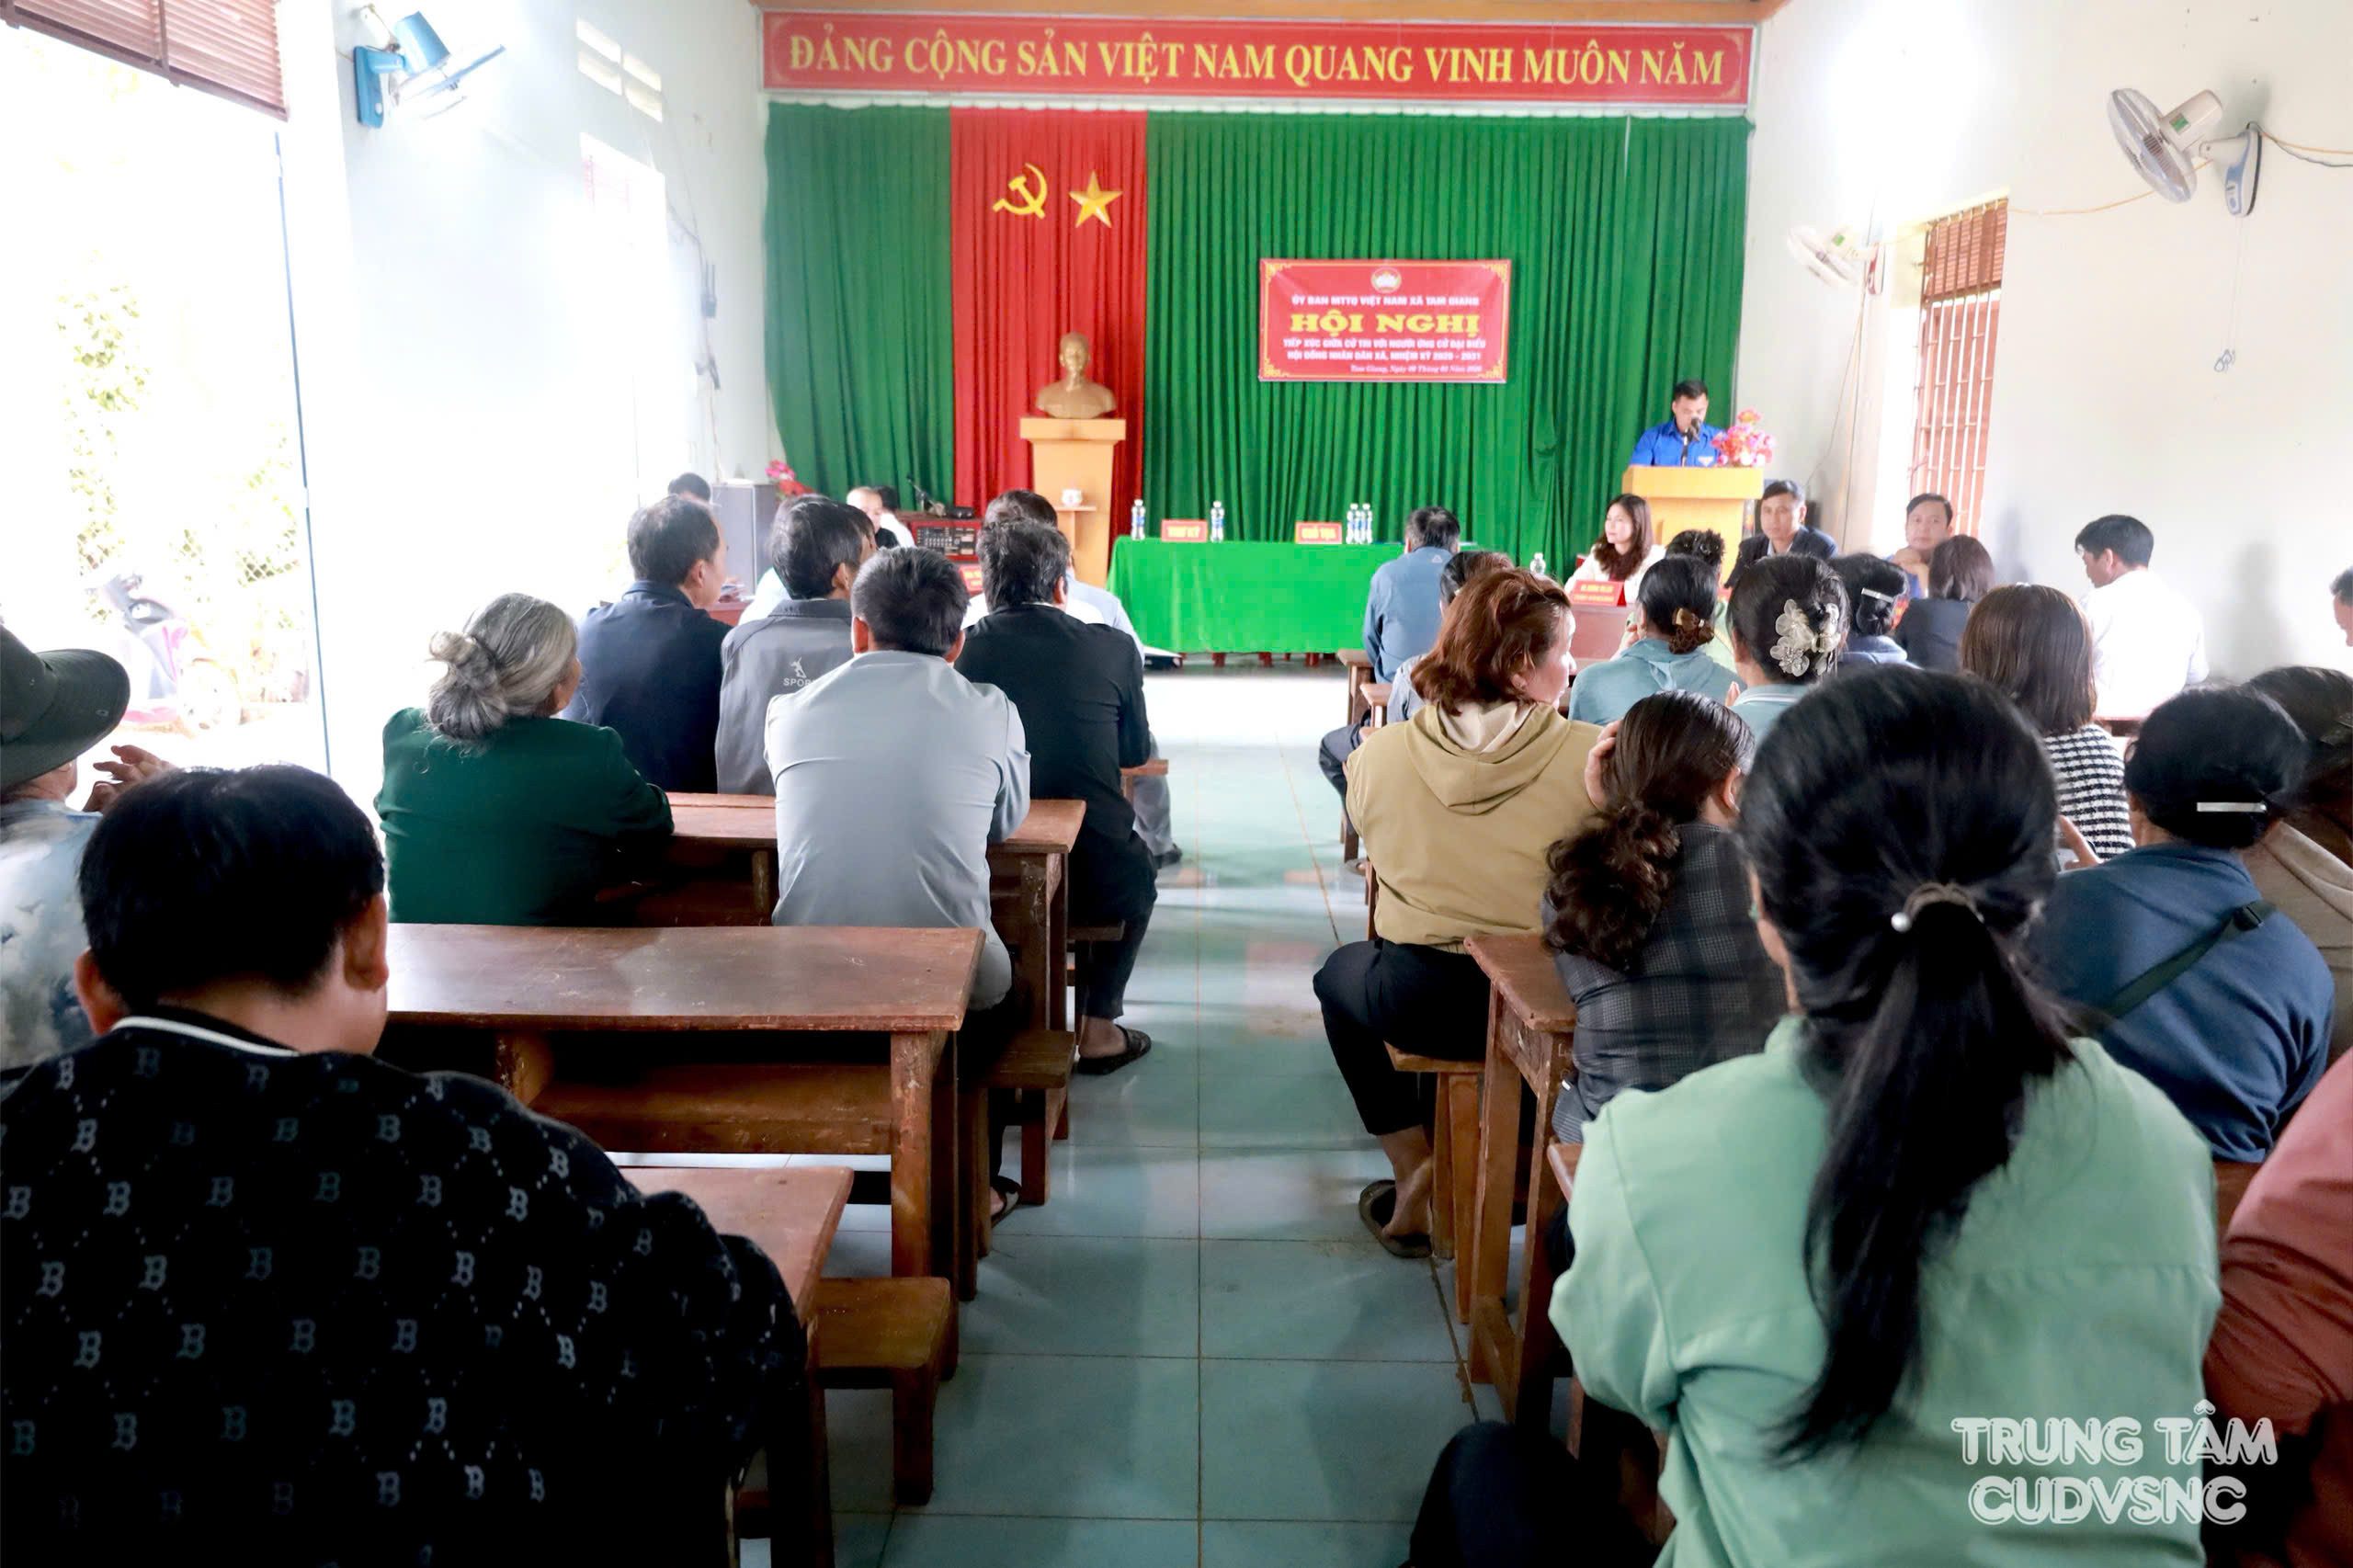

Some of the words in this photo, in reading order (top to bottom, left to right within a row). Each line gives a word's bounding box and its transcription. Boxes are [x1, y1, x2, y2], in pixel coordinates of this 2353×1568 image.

[789, 29, 893, 72] ĐẢNG
[904, 29, 1007, 80] CỘNG
[1017, 29, 1088, 77] SẢN
[1097, 32, 1186, 85] VIỆT
[1193, 43, 1277, 80] NAM
[1284, 44, 1414, 87] QUANG
[1425, 47, 1513, 83] VINH
[1522, 40, 1632, 85] MUÔN
[1639, 41, 1724, 85] NĂM
[1307, 296, 1328, 306] BAN
[1360, 295, 1381, 308] VIỆT
[1383, 296, 1406, 306] NAM
[1426, 296, 1447, 306] TAM
[1449, 296, 1480, 306] GIANG
[1290, 308, 1364, 338] HỘI
[1375, 313, 1480, 338] NGHỊ
[782, 677, 815, 687] SPOR
[68, 1119, 98, 1153] B
[377, 1112, 403, 1143] B
[547, 1146, 570, 1180] B
[2, 1185, 32, 1221] B
[104, 1179, 132, 1218] B
[205, 1176, 235, 1208] B
[415, 1173, 443, 1208] B
[506, 1185, 529, 1222] B
[35, 1259, 66, 1299] B
[137, 1254, 169, 1291] B
[450, 1250, 476, 1288] B
[523, 1265, 544, 1301] B
[586, 1280, 608, 1314] B
[74, 1330, 103, 1369] B
[175, 1324, 206, 1360] B
[391, 1317, 418, 1355] B
[556, 1333, 576, 1369] B
[110, 1412, 140, 1452] B
[325, 1397, 358, 1437] B
[422, 1397, 448, 1435] B
[375, 1471, 403, 1508] B
[464, 1463, 484, 1500] B
